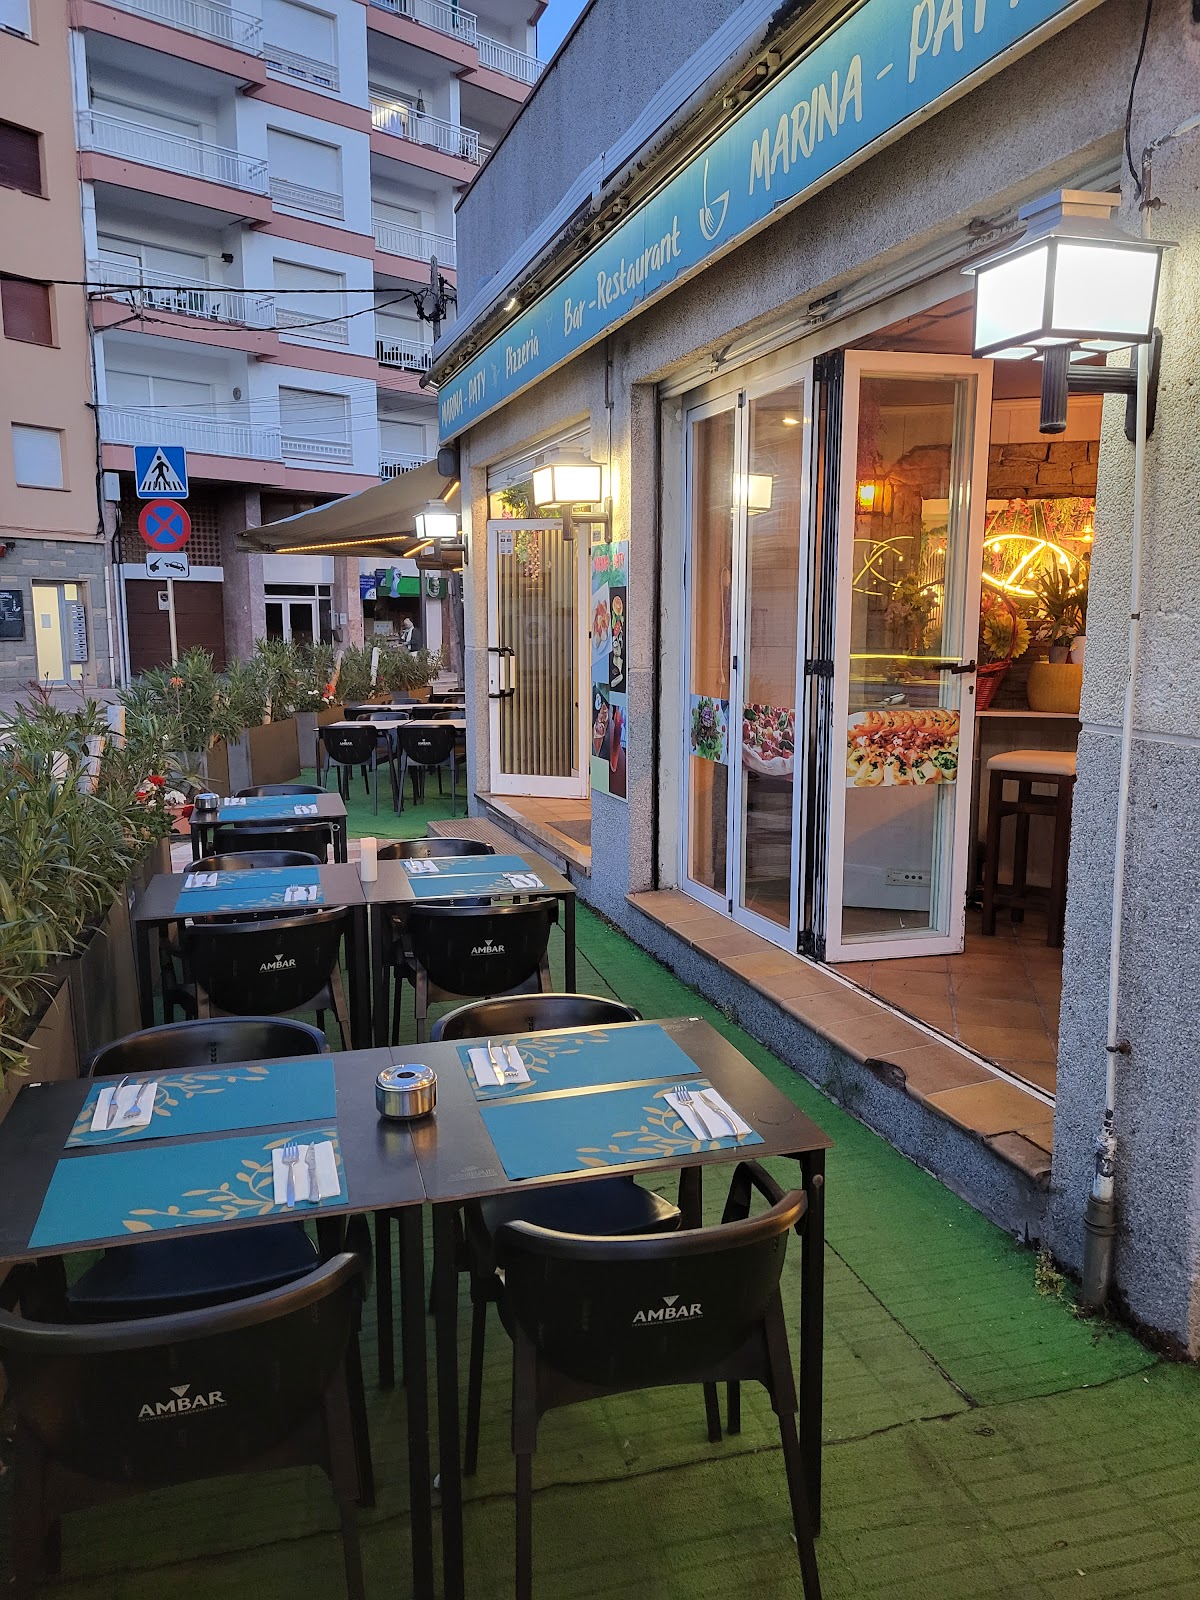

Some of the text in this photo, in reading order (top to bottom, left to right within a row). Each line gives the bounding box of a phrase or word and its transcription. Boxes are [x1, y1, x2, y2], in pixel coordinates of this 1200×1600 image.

[441, 388, 464, 428] MARINA
[468, 368, 486, 408] PATY
[506, 328, 539, 380] Pizzeria
[749, 54, 863, 196] MARINA
[908, 0, 1019, 83] PA
[470, 945, 506, 954] AMBAR
[260, 959, 296, 971] AMBAR
[632, 1303, 703, 1323] AMBAR
[138, 1391, 227, 1418] AMBAR
